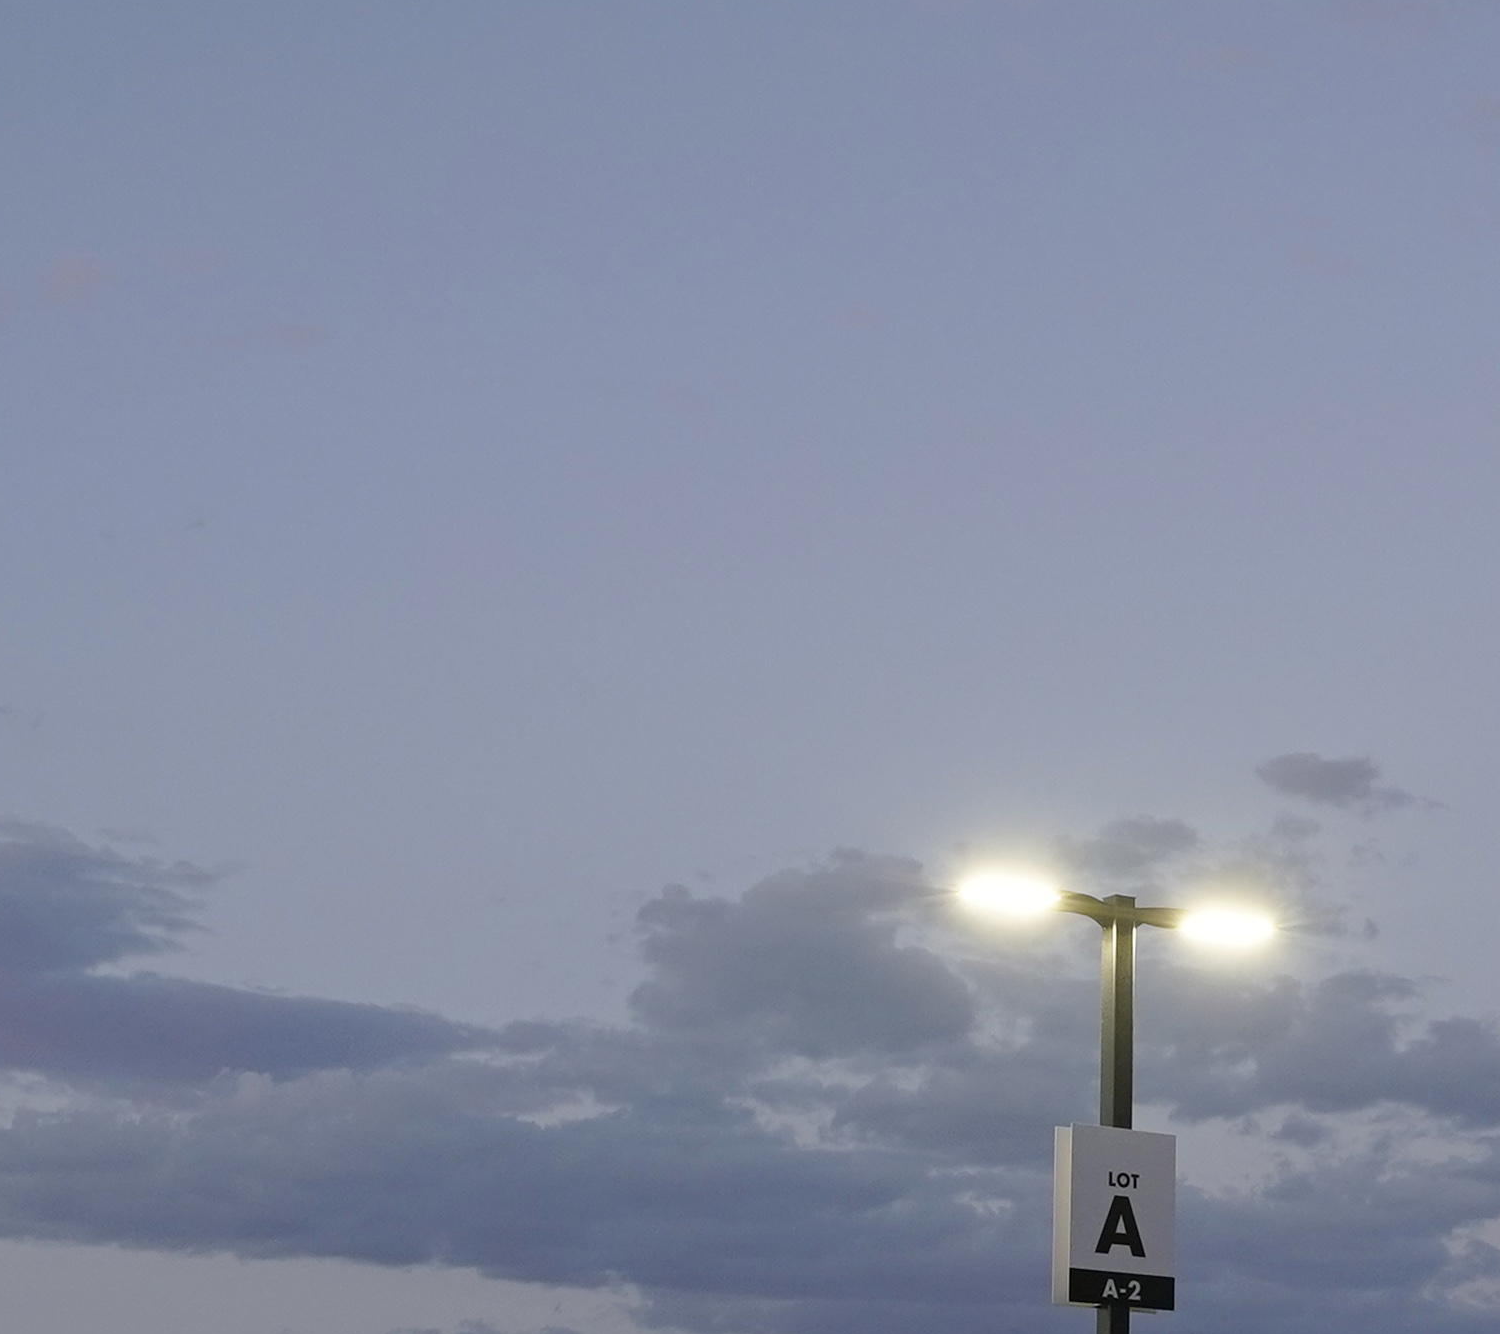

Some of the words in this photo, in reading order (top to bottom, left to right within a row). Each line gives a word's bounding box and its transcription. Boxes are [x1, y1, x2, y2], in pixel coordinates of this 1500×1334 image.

[1108, 1171, 1140, 1189] LOT
[1094, 1194, 1146, 1258] A
[1101, 1277, 1142, 1302] A-2
